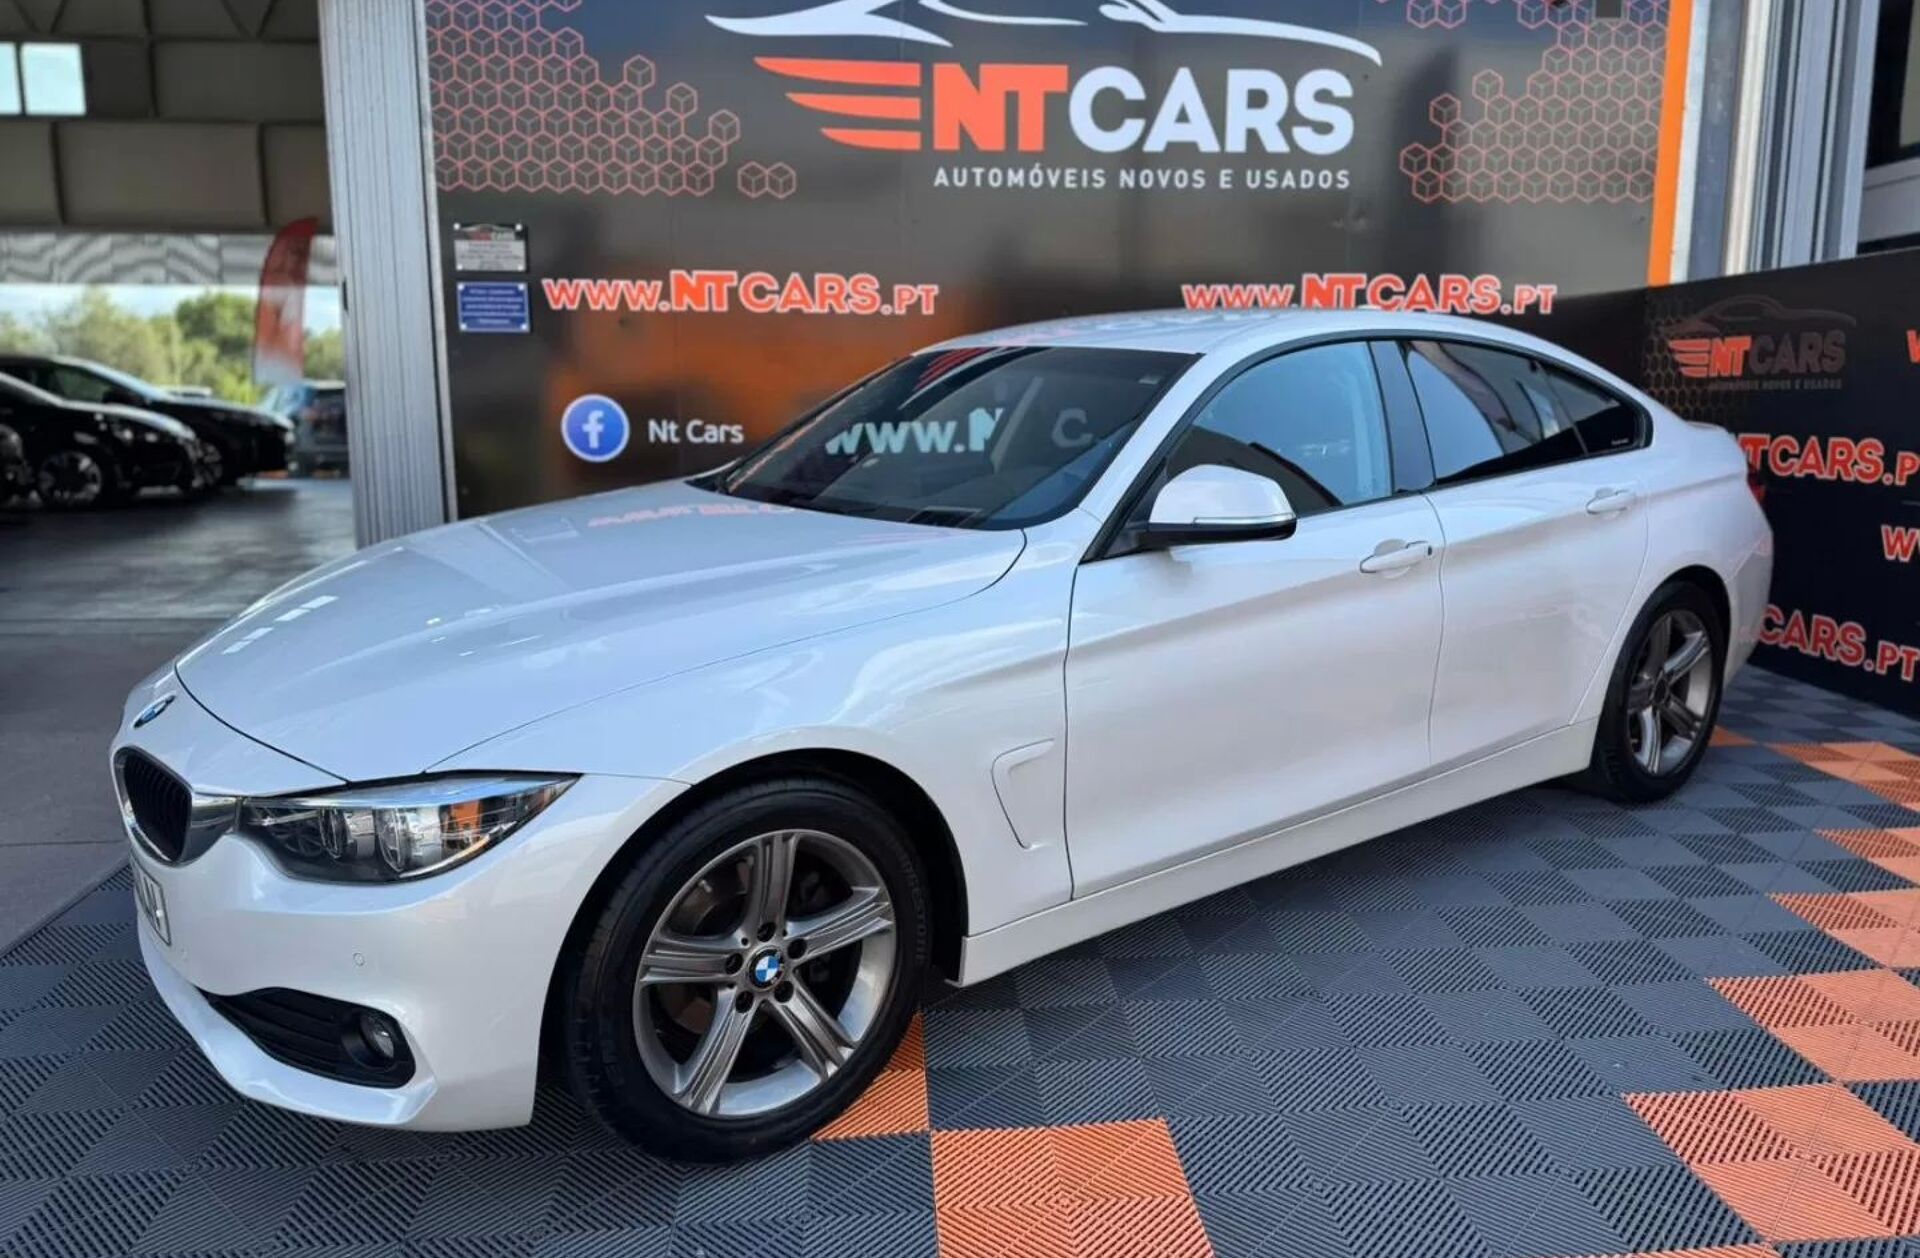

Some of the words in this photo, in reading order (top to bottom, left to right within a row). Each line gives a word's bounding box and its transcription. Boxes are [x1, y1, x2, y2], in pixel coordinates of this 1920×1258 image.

[934, 163, 1106, 188] AUTOMÓVEIS
[1119, 169, 1206, 189] NOVOS
[1219, 169, 1234, 188] E
[1246, 169, 1350, 189] USADOS
[648, 419, 680, 443] Nt
[686, 419, 744, 444] Cars
